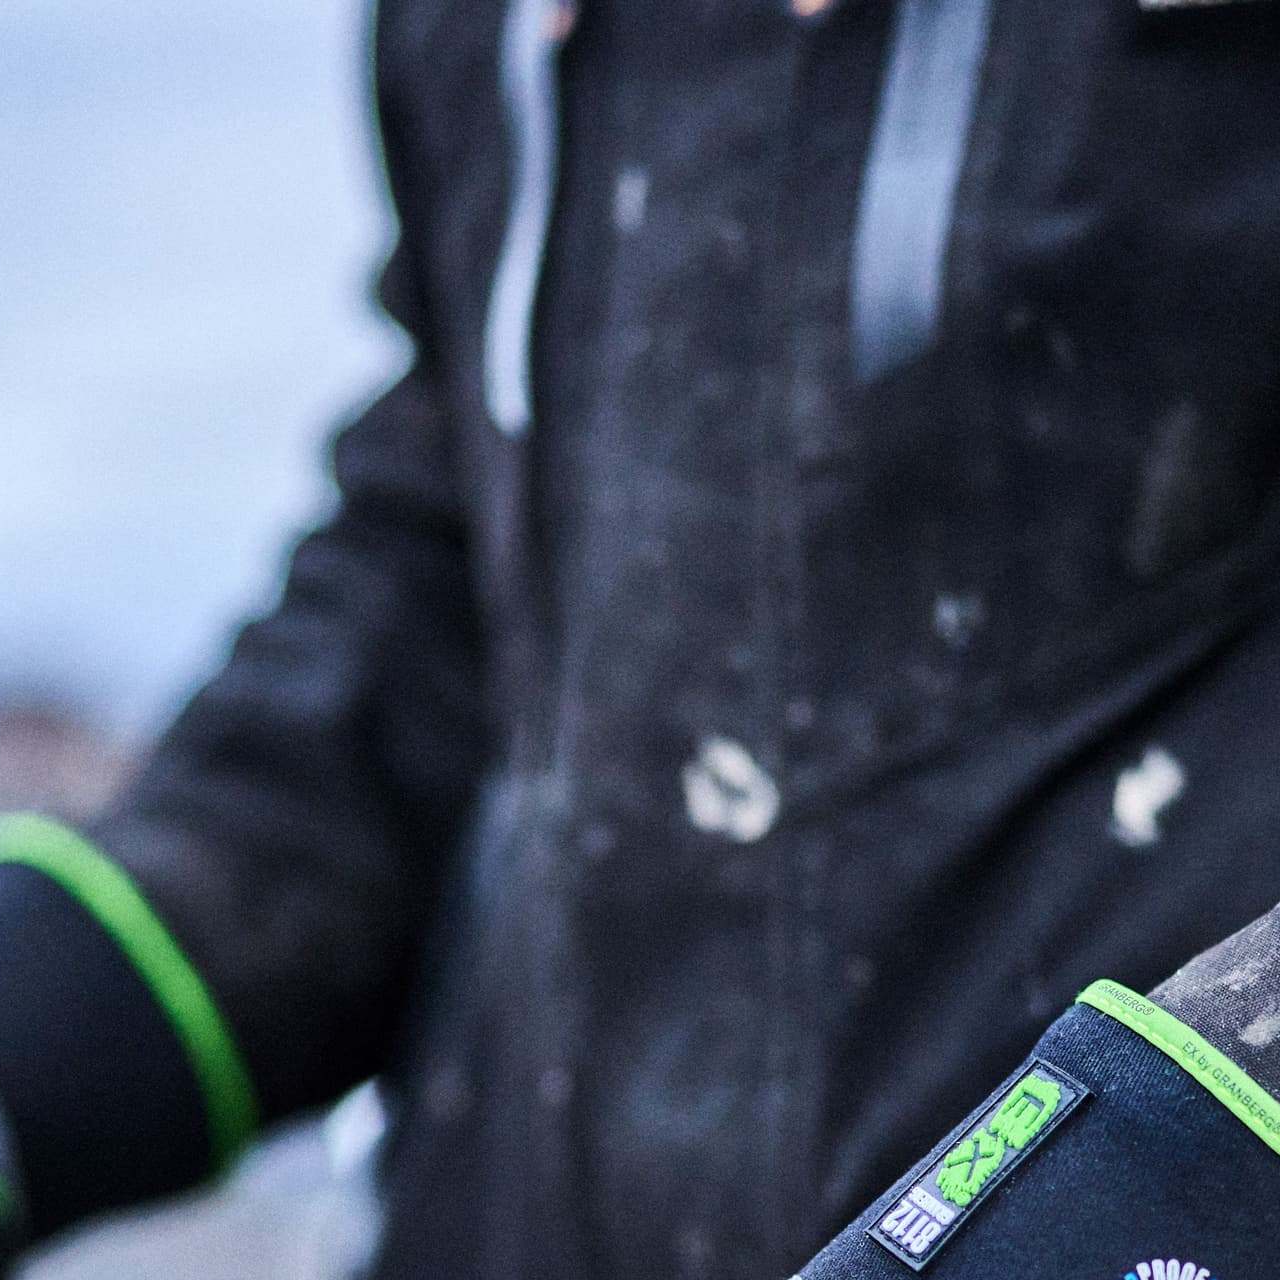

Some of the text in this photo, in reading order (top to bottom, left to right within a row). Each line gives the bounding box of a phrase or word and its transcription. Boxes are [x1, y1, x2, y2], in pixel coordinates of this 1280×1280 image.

[1182, 1040, 1199, 1058] EX
[1197, 1054, 1213, 1072] by
[879, 1200, 943, 1254] 8112
